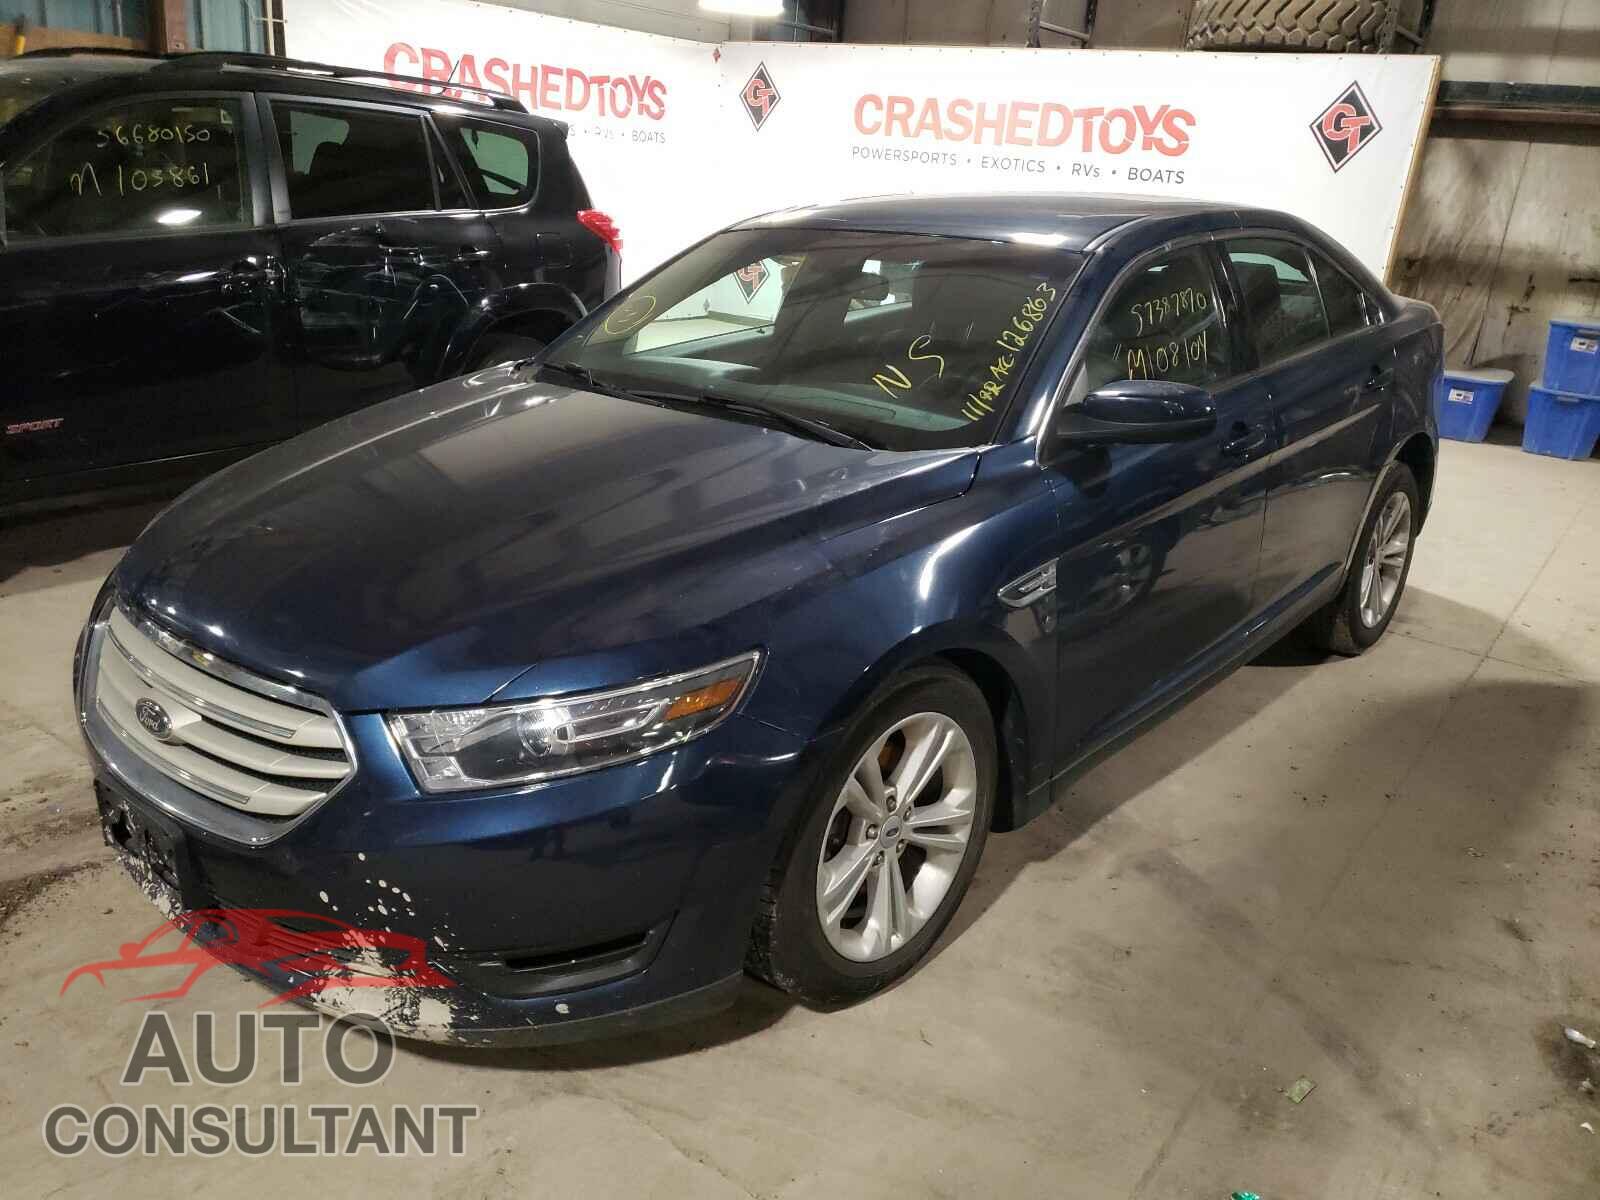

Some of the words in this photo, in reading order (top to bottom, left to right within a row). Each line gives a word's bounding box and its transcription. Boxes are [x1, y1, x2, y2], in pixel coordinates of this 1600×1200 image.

[383, 42, 667, 120] CRASHEDTOYS
[854, 93, 1196, 157] CRASHEDTOYS
[851, 146, 957, 166] POWERSPORTS
[981, 156, 1046, 173] EXOTICS
[1071, 163, 1101, 178] RVs
[1128, 167, 1185, 185] BOATS
[6, 417, 64, 434] SPORT
